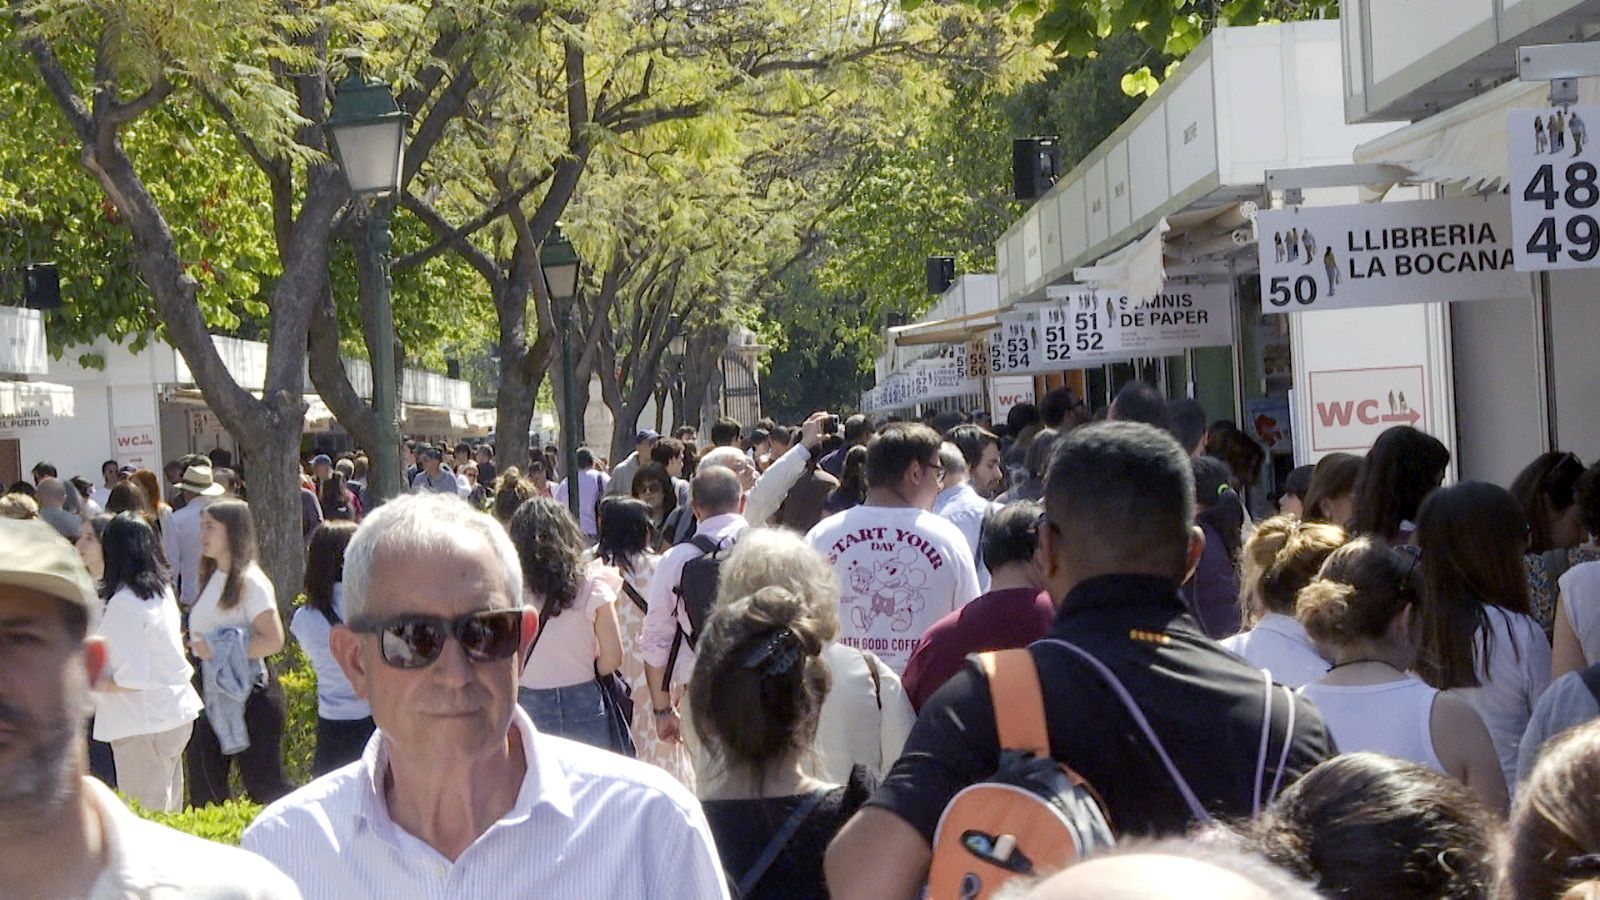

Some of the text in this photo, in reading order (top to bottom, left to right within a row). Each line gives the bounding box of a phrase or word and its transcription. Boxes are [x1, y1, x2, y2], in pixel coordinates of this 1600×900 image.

[1523, 161, 1599, 210] 48
[1348, 222, 1496, 251] LLIBRERIA
[1526, 214, 1600, 263] 49
[1349, 257, 1386, 279] LA
[1269, 275, 1317, 306] 50
[1119, 294, 1193, 310] SMNIS
[1075, 312, 1097, 331] 51
[1121, 310, 1208, 327] DE PAPER
[1046, 326, 1066, 343] 51
[1076, 332, 1104, 351] 52
[991, 344, 1005, 358] 5
[1007, 337, 1029, 352] 53
[1047, 344, 1071, 360] 52
[992, 359, 1006, 372] 5
[1008, 353, 1030, 368] 54
[1316, 399, 1379, 427] WC
[118, 435, 141, 447] WC
[871, 542, 895, 552] DAY
[896, 529, 943, 570] YOUR
[862, 637, 888, 650] GOOD
[891, 638, 921, 651] COFF
